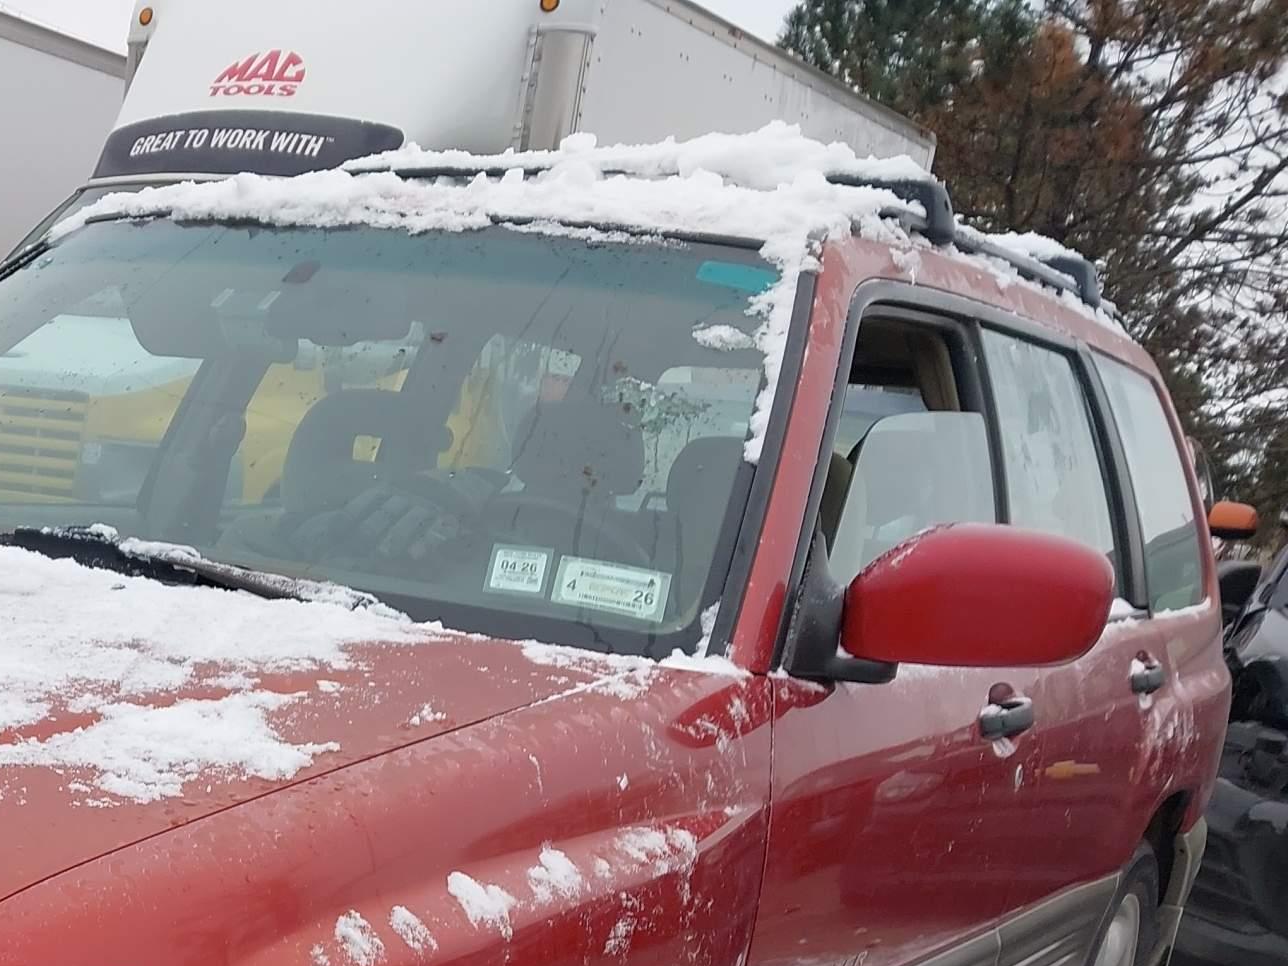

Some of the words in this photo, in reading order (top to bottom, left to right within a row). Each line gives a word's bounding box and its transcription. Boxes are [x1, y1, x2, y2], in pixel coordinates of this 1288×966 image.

[213, 49, 307, 83] MAC
[208, 83, 298, 97] TOOLS
[129, 130, 185, 158] GREAT
[184, 128, 210, 149] TO
[210, 128, 267, 150] WORK
[566, 578, 577, 591] 4
[632, 589, 655, 606] 26
